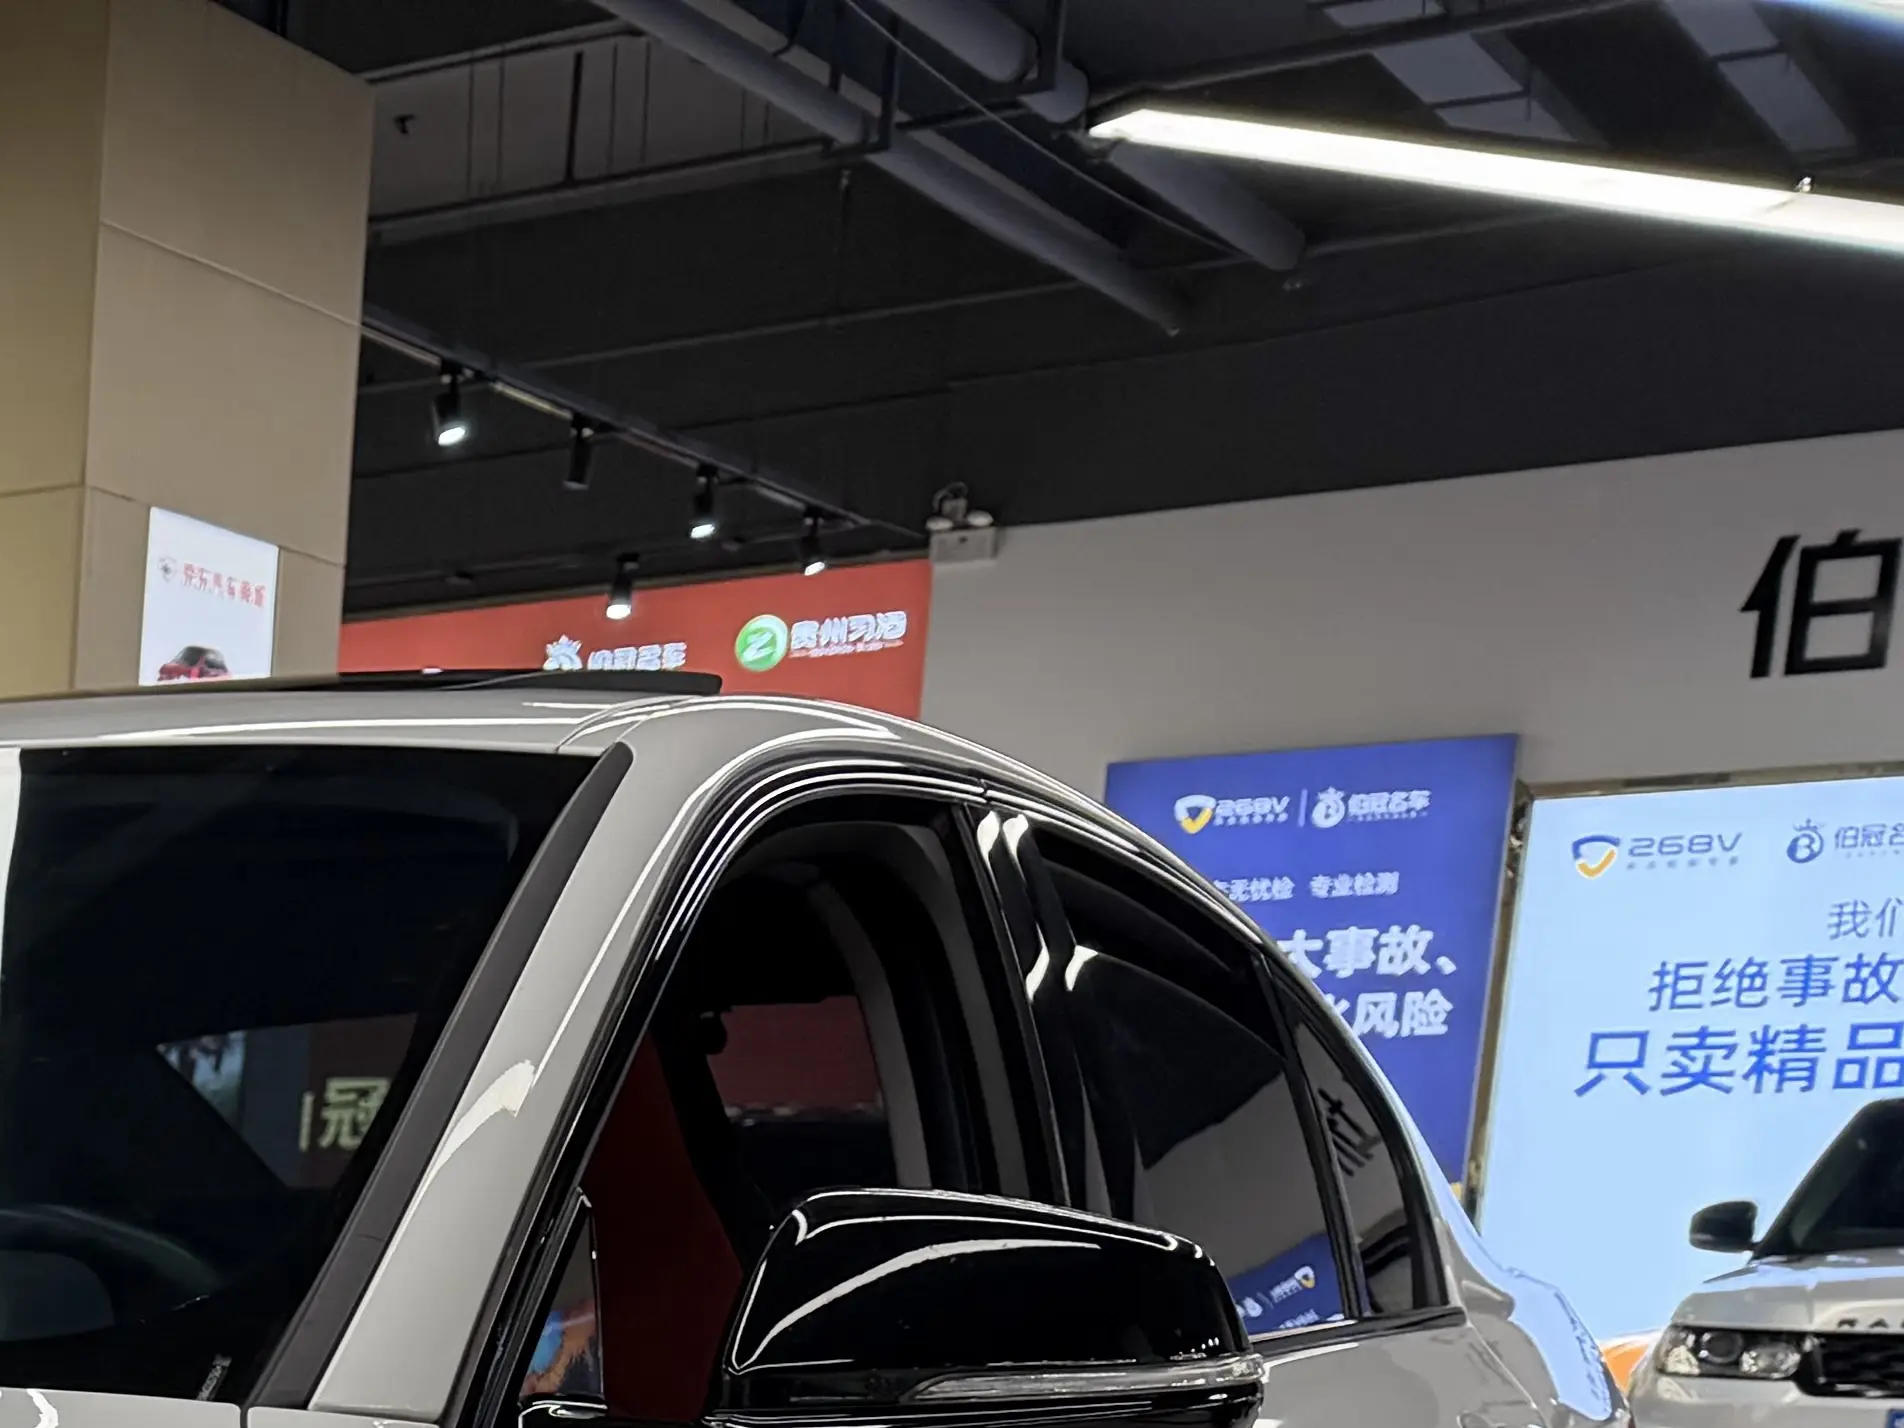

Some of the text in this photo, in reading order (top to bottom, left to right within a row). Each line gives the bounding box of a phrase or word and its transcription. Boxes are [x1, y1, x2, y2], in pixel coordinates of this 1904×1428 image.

[1739, 529, 1903, 679] 伯
[1627, 832, 1743, 857] 268V
[1648, 951, 1904, 1012] 拒绝事故
[1573, 1020, 1904, 1097] 只卖精品
